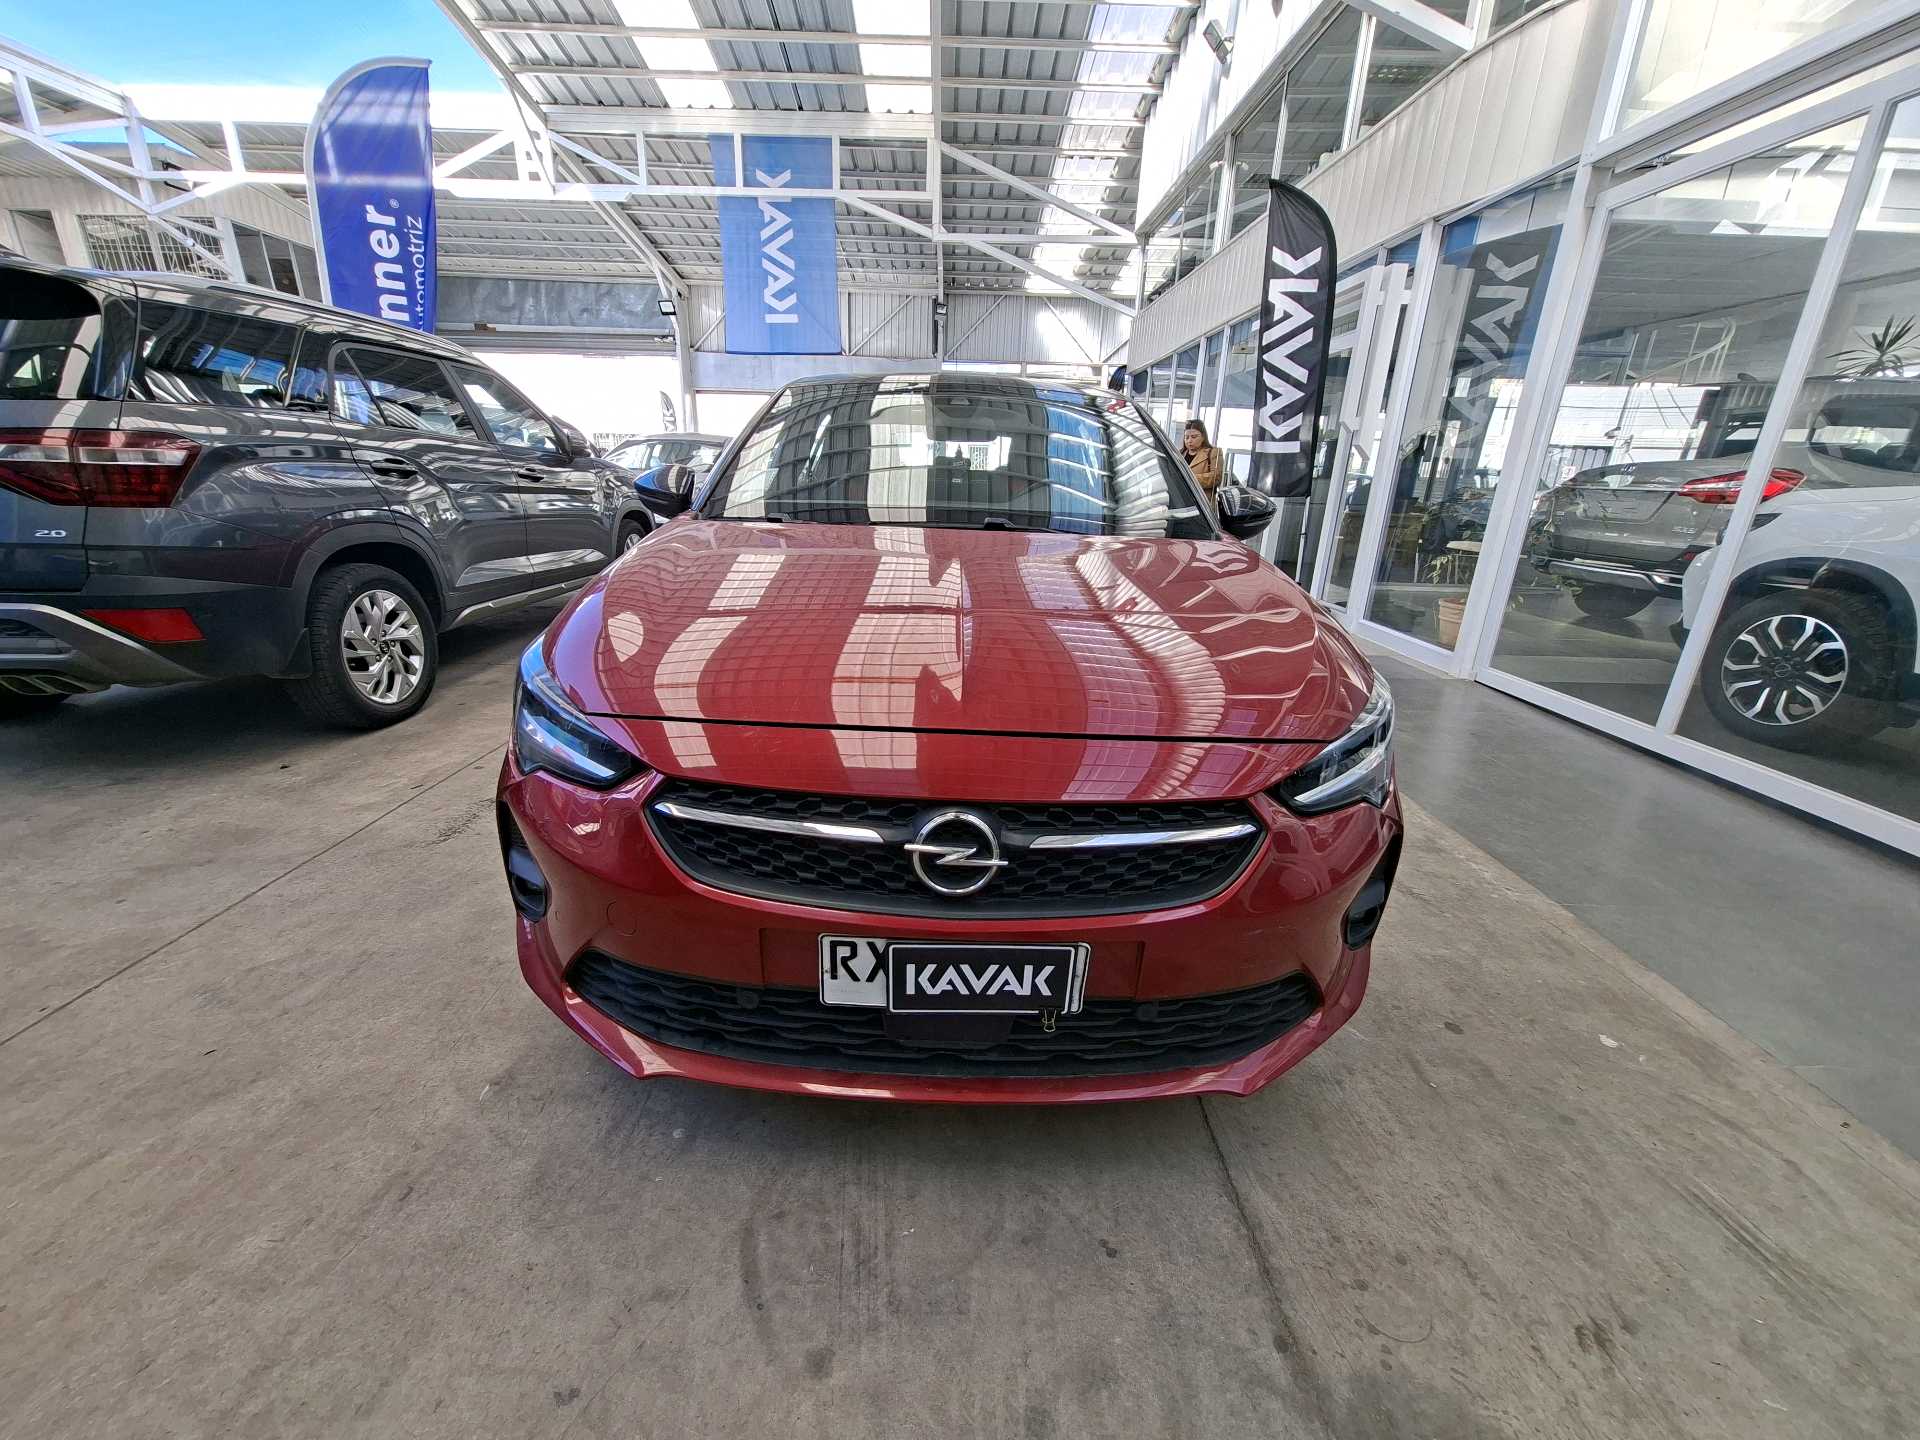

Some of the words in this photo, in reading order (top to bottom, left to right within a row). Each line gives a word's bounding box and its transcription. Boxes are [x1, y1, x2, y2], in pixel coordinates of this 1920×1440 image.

[756, 168, 799, 324] KAVAK
[1255, 245, 1322, 454] KAVAK
[905, 962, 1056, 996] KAVAK
